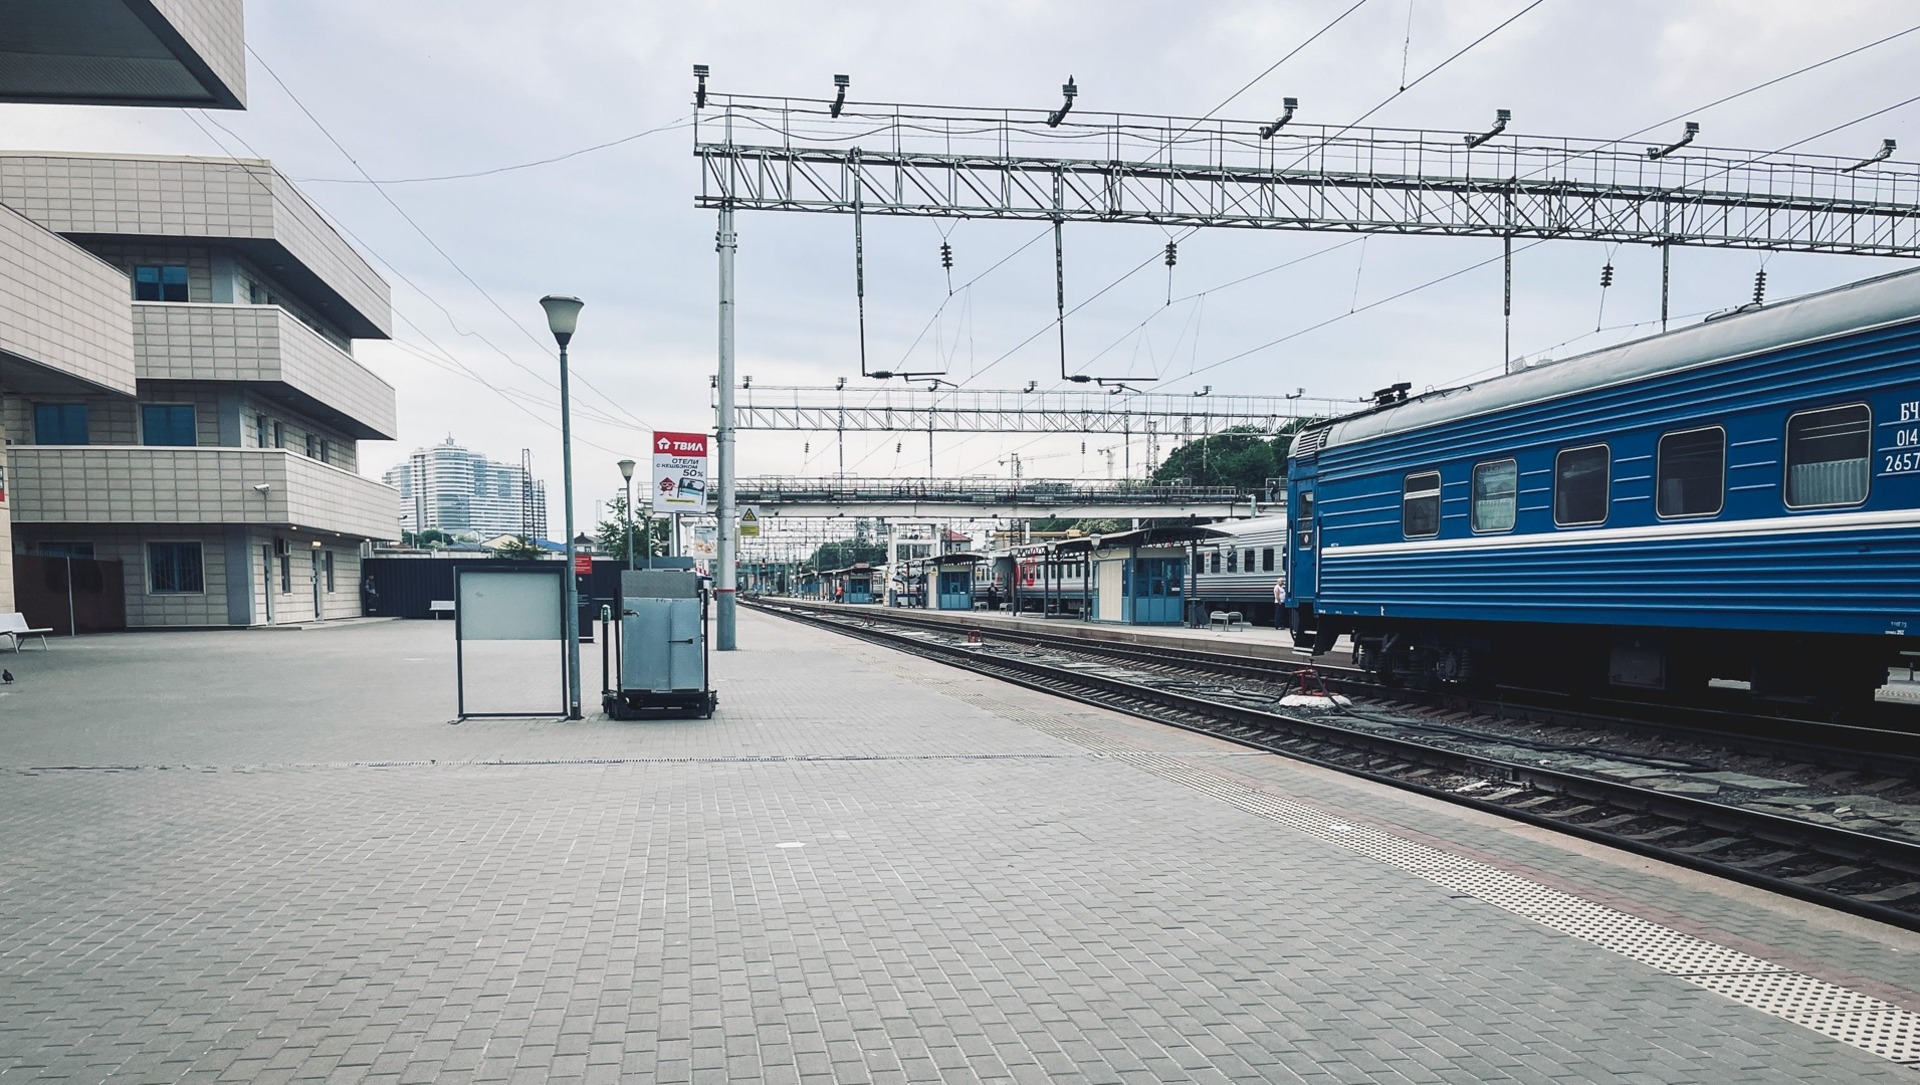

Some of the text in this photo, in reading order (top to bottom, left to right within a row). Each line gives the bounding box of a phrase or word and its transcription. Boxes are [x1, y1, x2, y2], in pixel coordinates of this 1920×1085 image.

[1900, 401, 1920, 421] БЧ
[1896, 428, 1918, 446] 014
[673, 441, 703, 451] ТВИЛ
[683, 469, 703, 477] 50%
